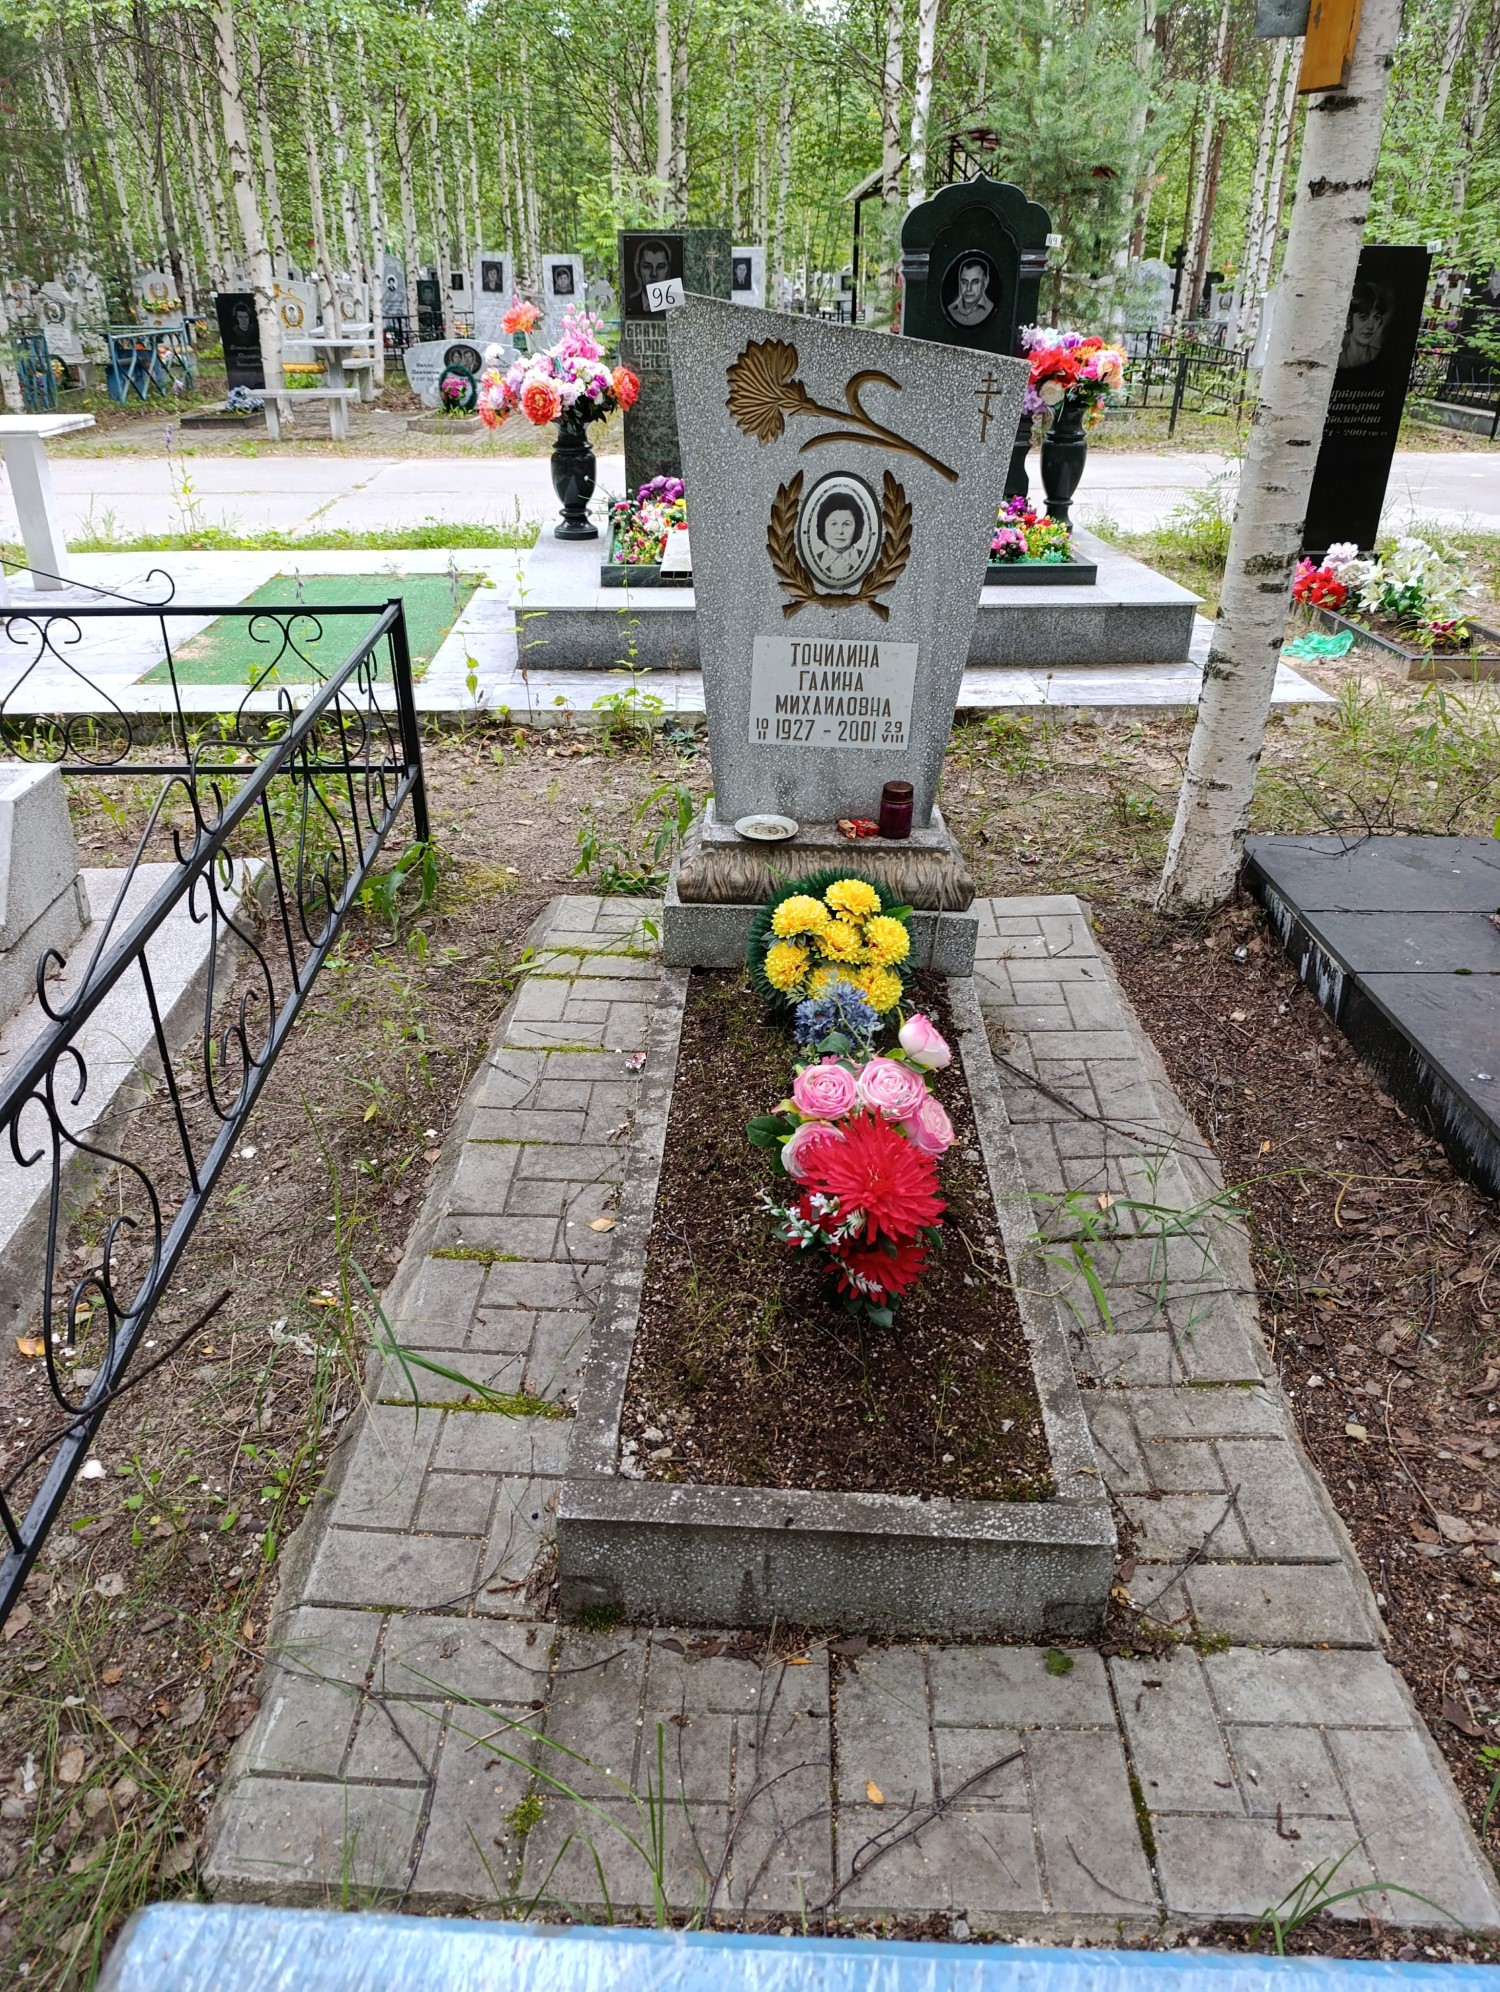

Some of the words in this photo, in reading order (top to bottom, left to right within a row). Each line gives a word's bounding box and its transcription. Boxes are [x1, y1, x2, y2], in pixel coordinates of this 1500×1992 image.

[652, 284, 676, 308] 96
[634, 339, 669, 354] ЯРОС
[1343, 429, 1367, 437] 2001
[790, 643, 880, 668] ТОЧИЛИНА
[799, 670, 864, 692] ГАЛИНА
[775, 694, 892, 717] МИХАИЛОВНА
[756, 717, 769, 730] 10
[775, 718, 816, 742] 1927
[837, 720, 877, 743] 2001
[884, 721, 903, 733] 29
[881, 733, 904, 744] VIII
